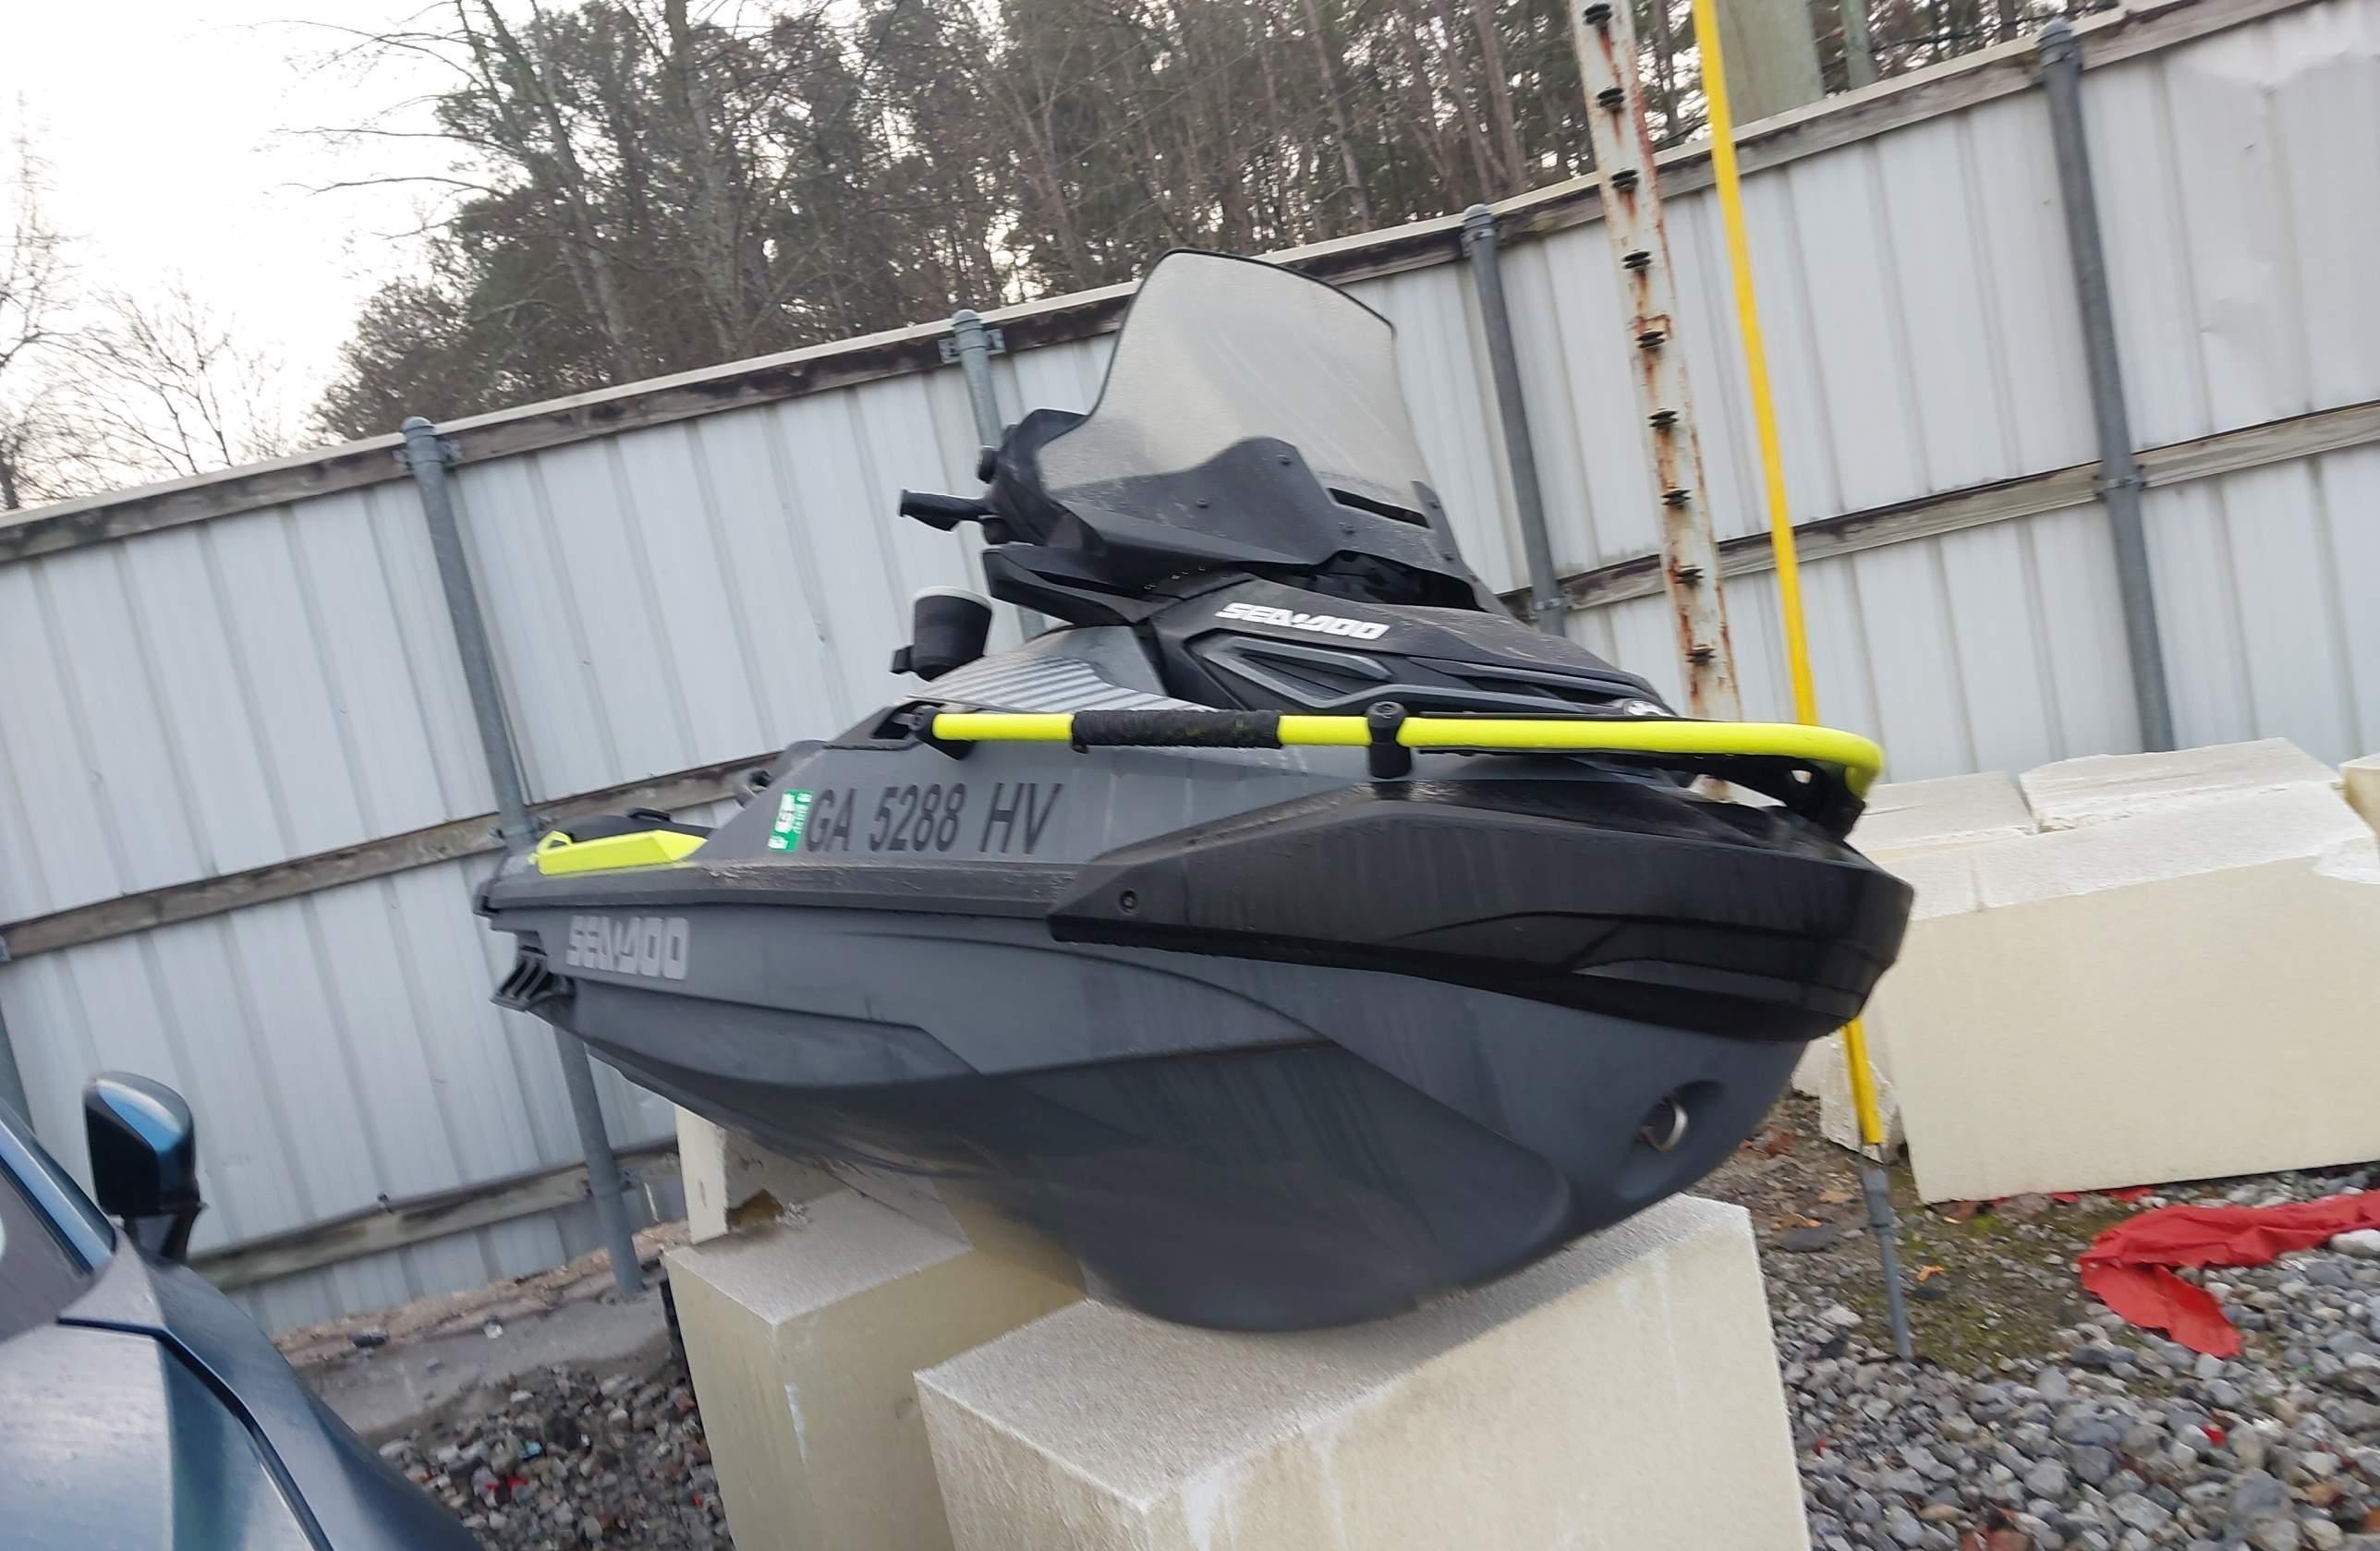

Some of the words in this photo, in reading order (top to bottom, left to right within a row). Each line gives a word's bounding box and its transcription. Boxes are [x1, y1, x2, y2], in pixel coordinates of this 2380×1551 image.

[806, 788, 857, 853] GA
[868, 782, 965, 853] 5288
[978, 782, 1063, 854] HV
